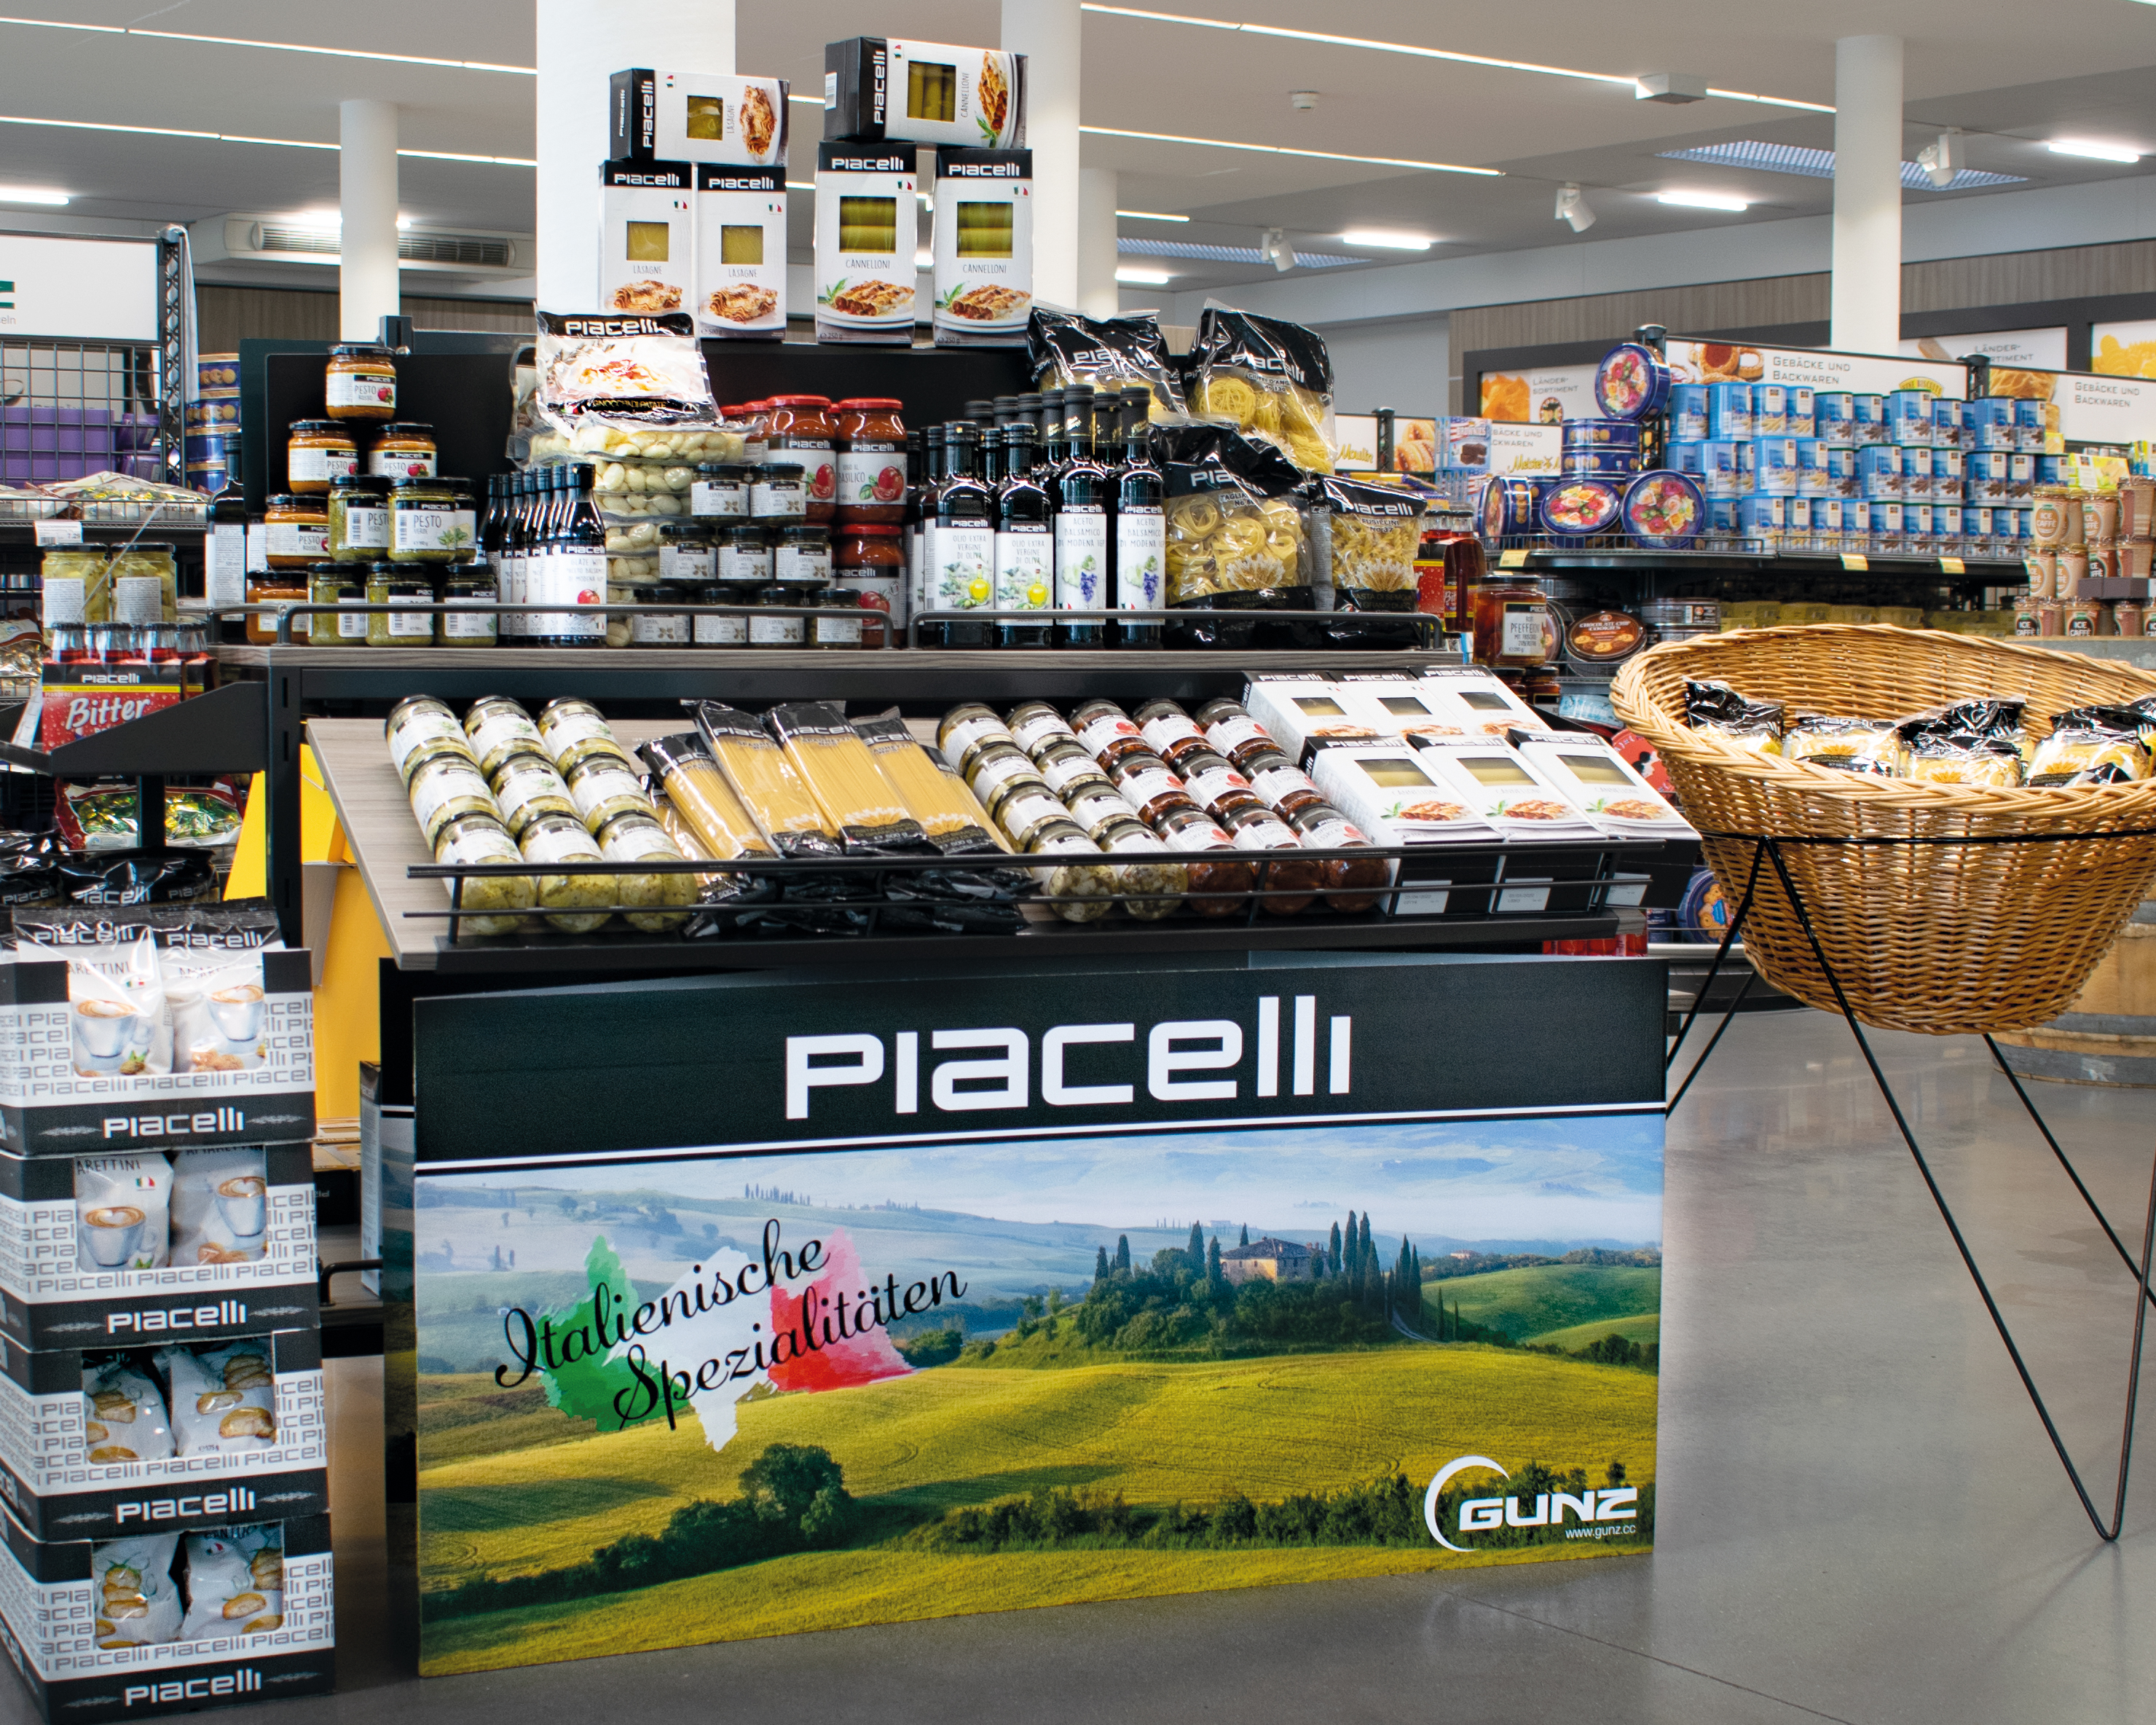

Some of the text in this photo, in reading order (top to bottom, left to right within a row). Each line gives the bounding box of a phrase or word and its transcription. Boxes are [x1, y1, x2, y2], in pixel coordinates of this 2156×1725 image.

[873, 50, 886, 125] Piacelli
[960, 72, 969, 118] CANNELLONI
[642, 80, 653, 149] Piacelli
[726, 104, 735, 134] LASAGNE
[832, 157, 904, 170] Piacelli
[948, 162, 1020, 176] Piacelli
[614, 173, 680, 186] Piacelli
[709, 176, 774, 189] Piacelli
[633, 264, 662, 275] LASAGNE
[846, 259, 890, 270] CANNELLONI
[962, 264, 1007, 274] CANNELLONI
[728, 269, 758, 278] LASAGNE
[565, 318, 658, 336] Piacelli
[1073, 348, 1157, 368] Piaelli
[1773, 355, 1851, 372] GEBÄCKE UND
[1990, 353, 2034, 363] RTIMENT
[1773, 370, 1840, 385] BACKWAREN
[355, 385, 376, 396] PESTO
[1533, 385, 1578, 395] SORTIMENT
[2075, 382, 2140, 396] GEBÄCKE UND
[2075, 394, 2131, 407] BACKWAREN
[1492, 428, 1521, 437] BÄCKE
[789, 440, 830, 449] Piacelli
[851, 443, 894, 452] Piacelli
[328, 460, 347, 471] PESTO
[385, 462, 406, 472] PESTO
[1062, 504, 1103, 513] Piacelli
[1125, 506, 1163, 514] Piacelli
[1343, 503, 1413, 516] Piacelli
[413, 514, 442, 528] PESTO
[951, 519, 988, 527] Piacelli
[1073, 517, 1093, 526] ACETO
[1136, 518, 1156, 526] ACETO
[1010, 524, 1047, 533] Piacelli
[1064, 527, 1101, 536] BALSAMICO
[1128, 528, 1162, 536] BALSAMICO
[299, 535, 320, 544] PESTO
[953, 535, 986, 543] OLIO EXTRA
[1012, 540, 1026, 548] OLIO
[1066, 539, 1095, 547] MODENA
[1129, 539, 1158, 547] MODENA
[566, 546, 605, 554] Piacelli
[957, 543, 982, 551] VERGINE
[82, 673, 140, 684] Piacelli
[1258, 672, 1323, 682] Piacelli
[1343, 672, 1407, 682] Piacelli
[1424, 668, 1487, 677] Piacelli
[66, 696, 150, 731] Bitter
[866, 733, 915, 746] acelli
[1326, 739, 1401, 748] Piacelli
[1428, 736, 1503, 747] Piacelli
[1530, 734, 1600, 744] Piacelli
[874, 743, 910, 753] AGHETTI
[167, 930, 262, 948] Piacelli
[68, 962, 130, 976] ARETTINI
[786, 995, 1351, 1120] Piacelli
[234, 1066, 313, 1085] Piacel
[34, 1077, 128, 1096] Piacelli
[134, 1074, 227, 1091] Piacelli
[103, 1107, 244, 1139] Piacelli
[76, 1159, 142, 1175] ARETTINI
[138, 1267, 231, 1286] Piacelli
[38, 1275, 131, 1294] Piacelli
[495, 1219, 831, 1388] Italienische
[107, 1300, 247, 1334] Piacelli
[613, 1270, 968, 1431] Spezialitäten
[146, 1455, 240, 1476] Piacelli
[47, 1464, 141, 1485] Piacelli
[117, 1487, 256, 1523] Piacelli
[1459, 1487, 1637, 1531] GUNZ
[1565, 1524, 1636, 1540] www.gunz.cc
[154, 1638, 246, 1659] Piacelli
[55, 1649, 149, 1671] Piacelli
[125, 1668, 261, 1707] Piacelli
